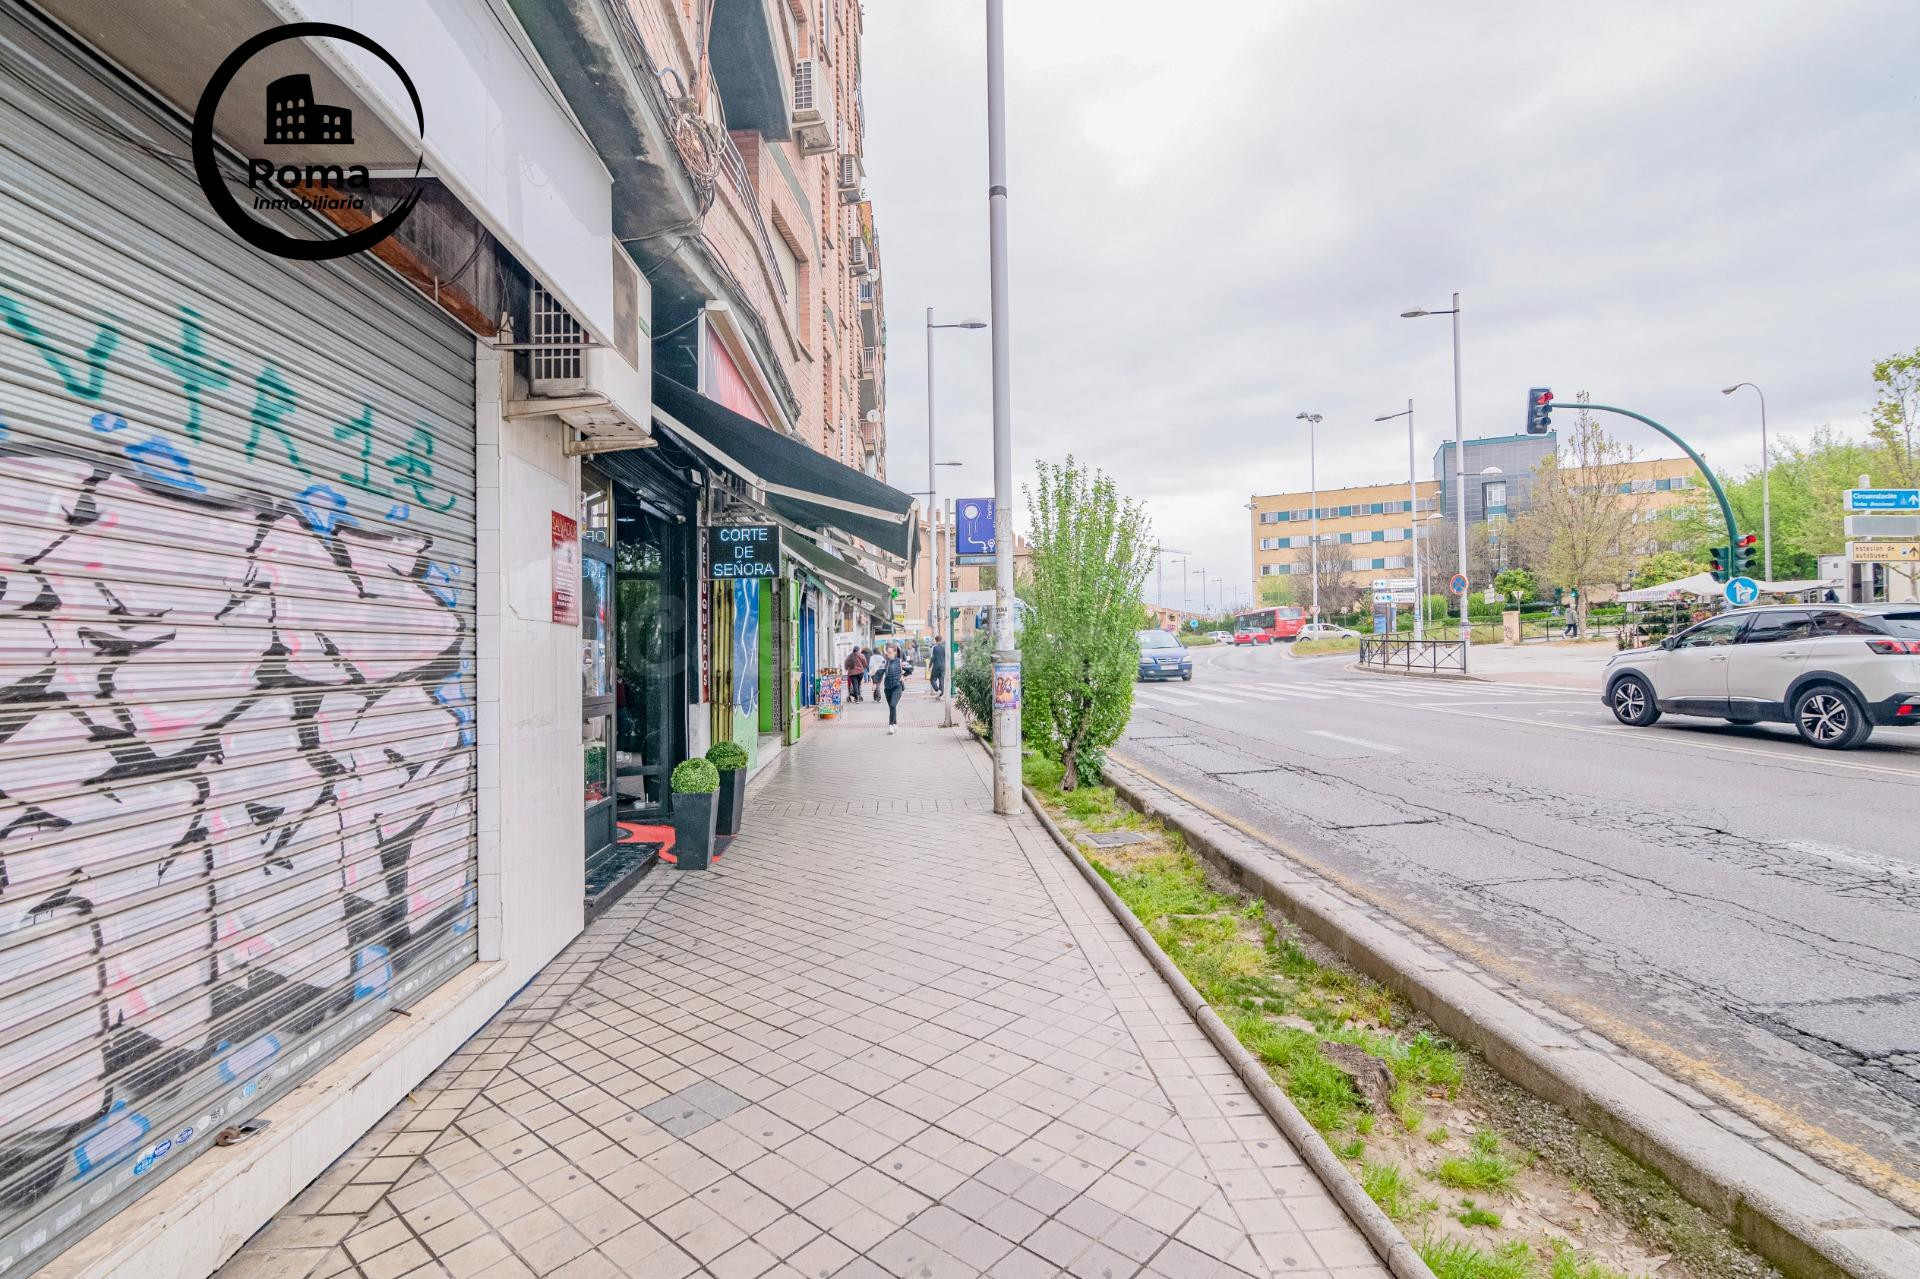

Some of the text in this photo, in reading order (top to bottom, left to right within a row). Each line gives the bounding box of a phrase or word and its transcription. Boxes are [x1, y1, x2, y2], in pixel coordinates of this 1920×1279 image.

[720, 528, 768, 541] CORTE
[734, 546, 754, 558] DE
[713, 560, 775, 576] SEÑORA
